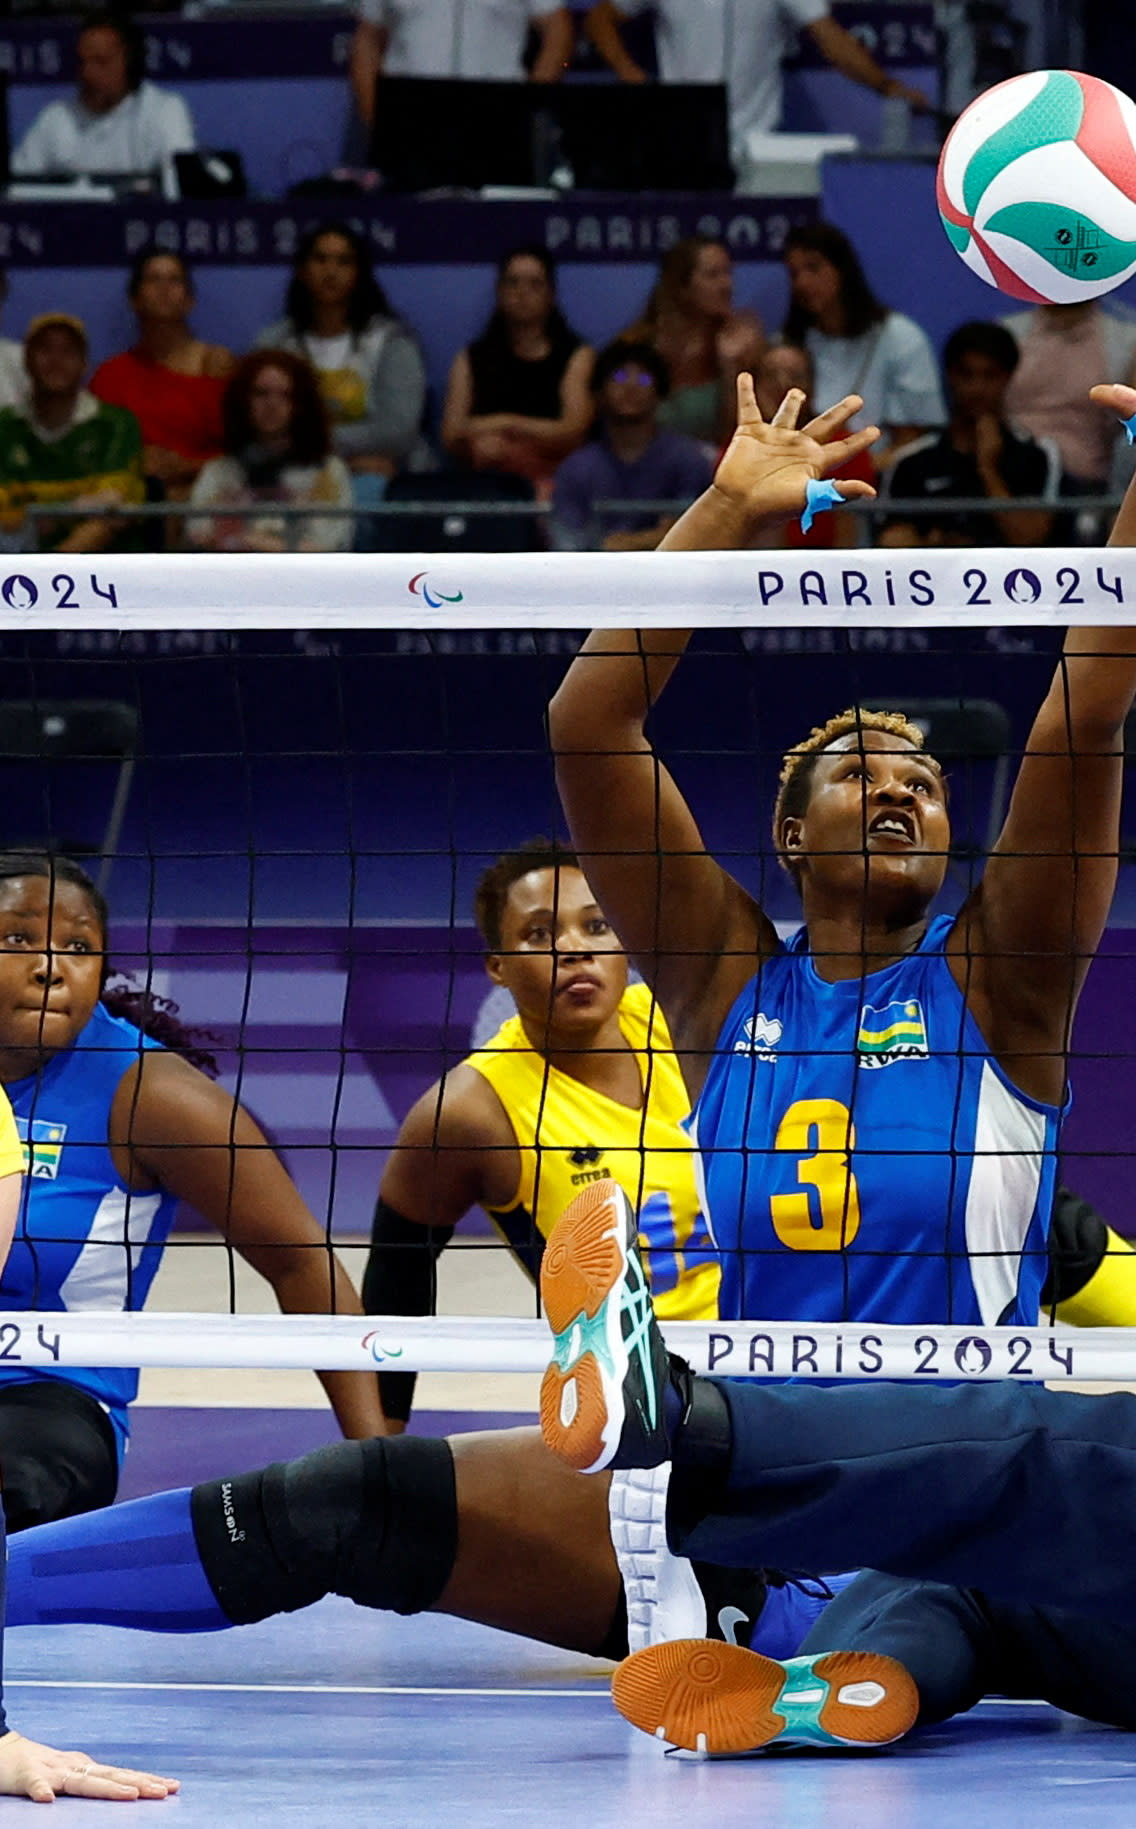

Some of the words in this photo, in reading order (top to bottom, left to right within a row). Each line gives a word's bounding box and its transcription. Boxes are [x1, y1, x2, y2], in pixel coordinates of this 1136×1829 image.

[963, 568, 1123, 605] 2024
[770, 1099, 862, 1251] 3
[914, 1336, 1072, 1375] 2024
